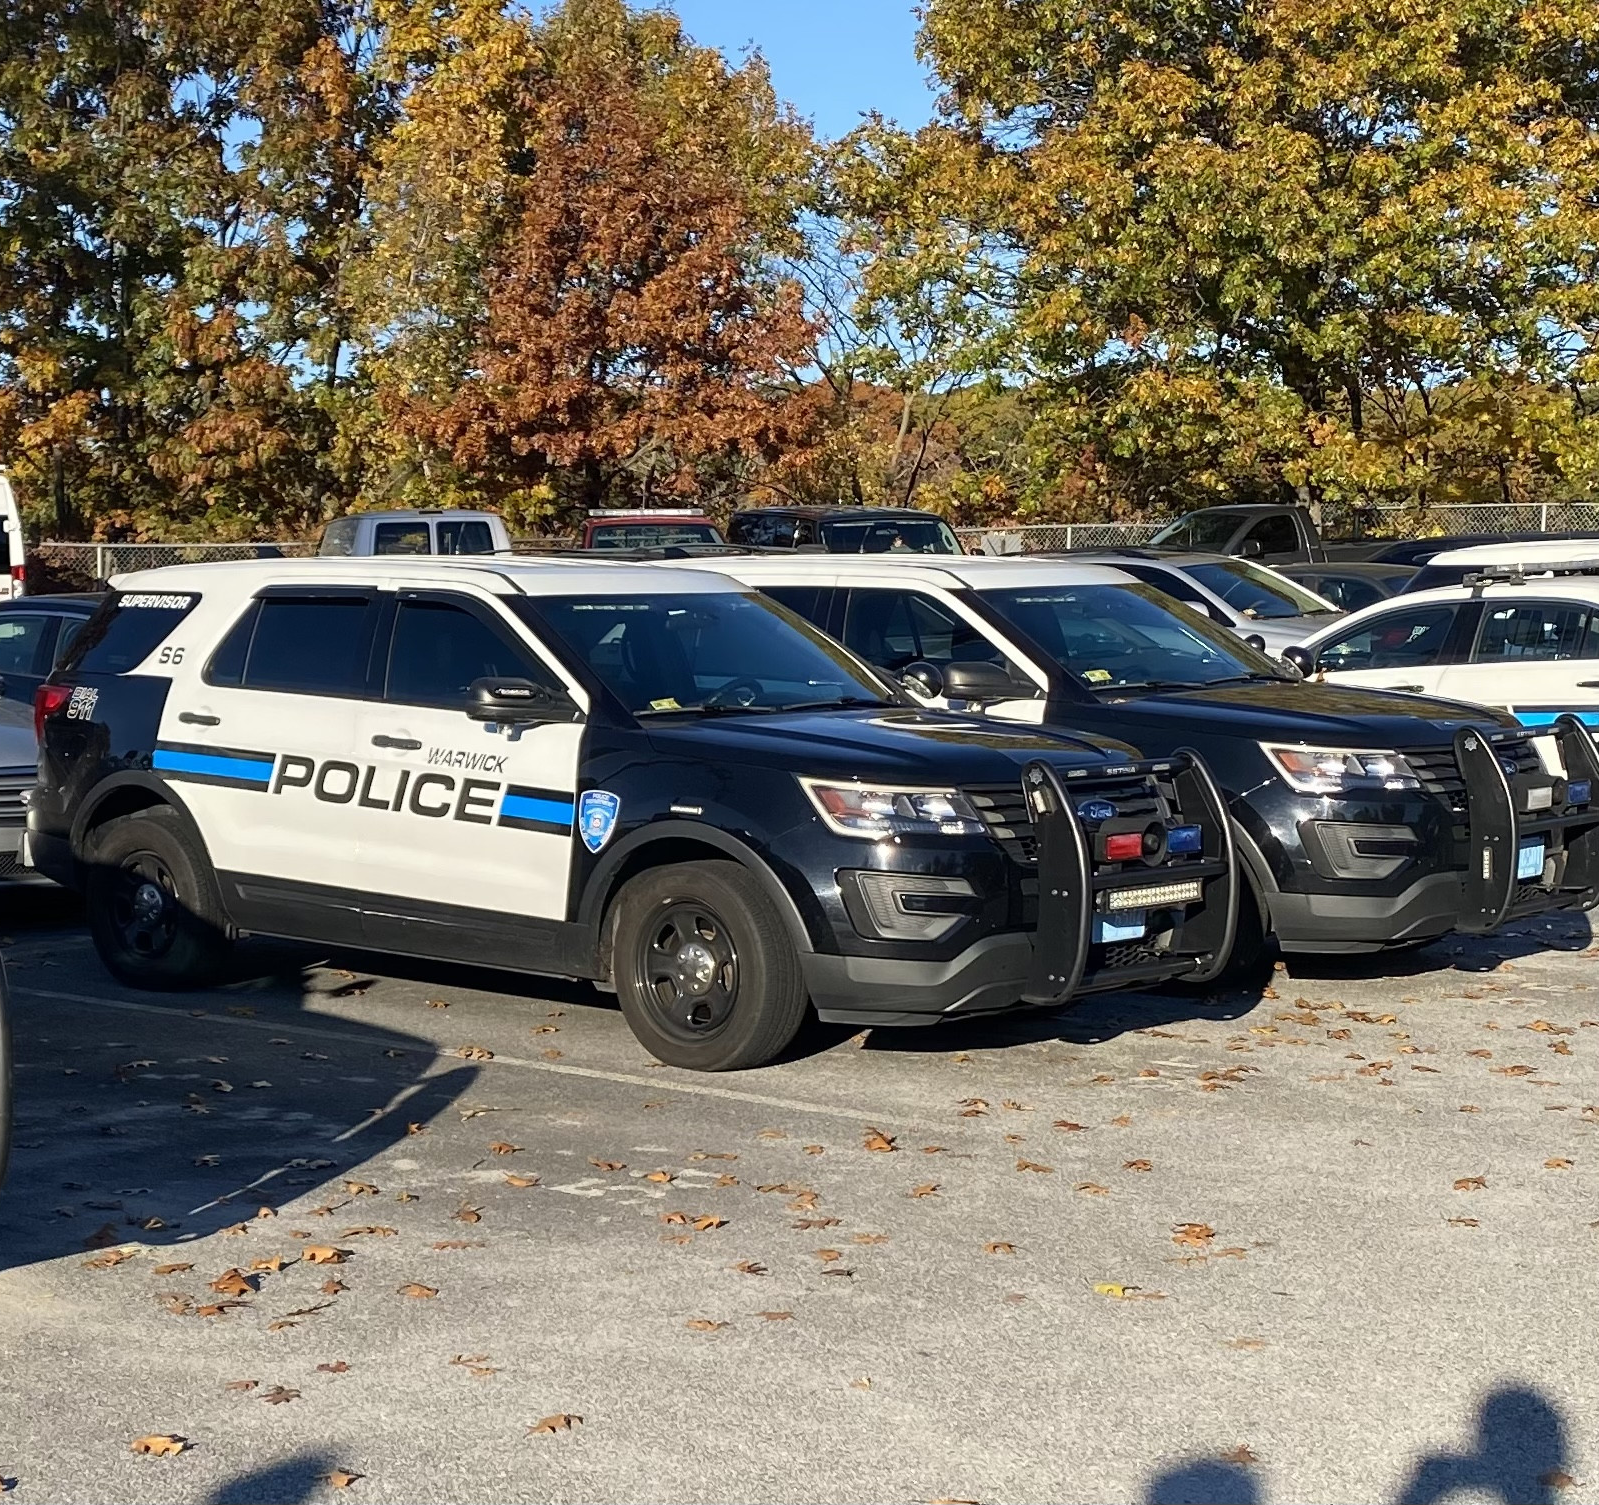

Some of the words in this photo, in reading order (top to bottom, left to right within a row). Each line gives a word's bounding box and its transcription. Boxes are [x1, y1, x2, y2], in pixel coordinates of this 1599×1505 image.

[118, 594, 192, 609] SUPERVISOR
[159, 646, 185, 665] S6
[72, 686, 99, 700] DIAL
[67, 698, 97, 720] 911
[427, 747, 509, 773] WARWICK
[273, 754, 501, 825] POLICE
